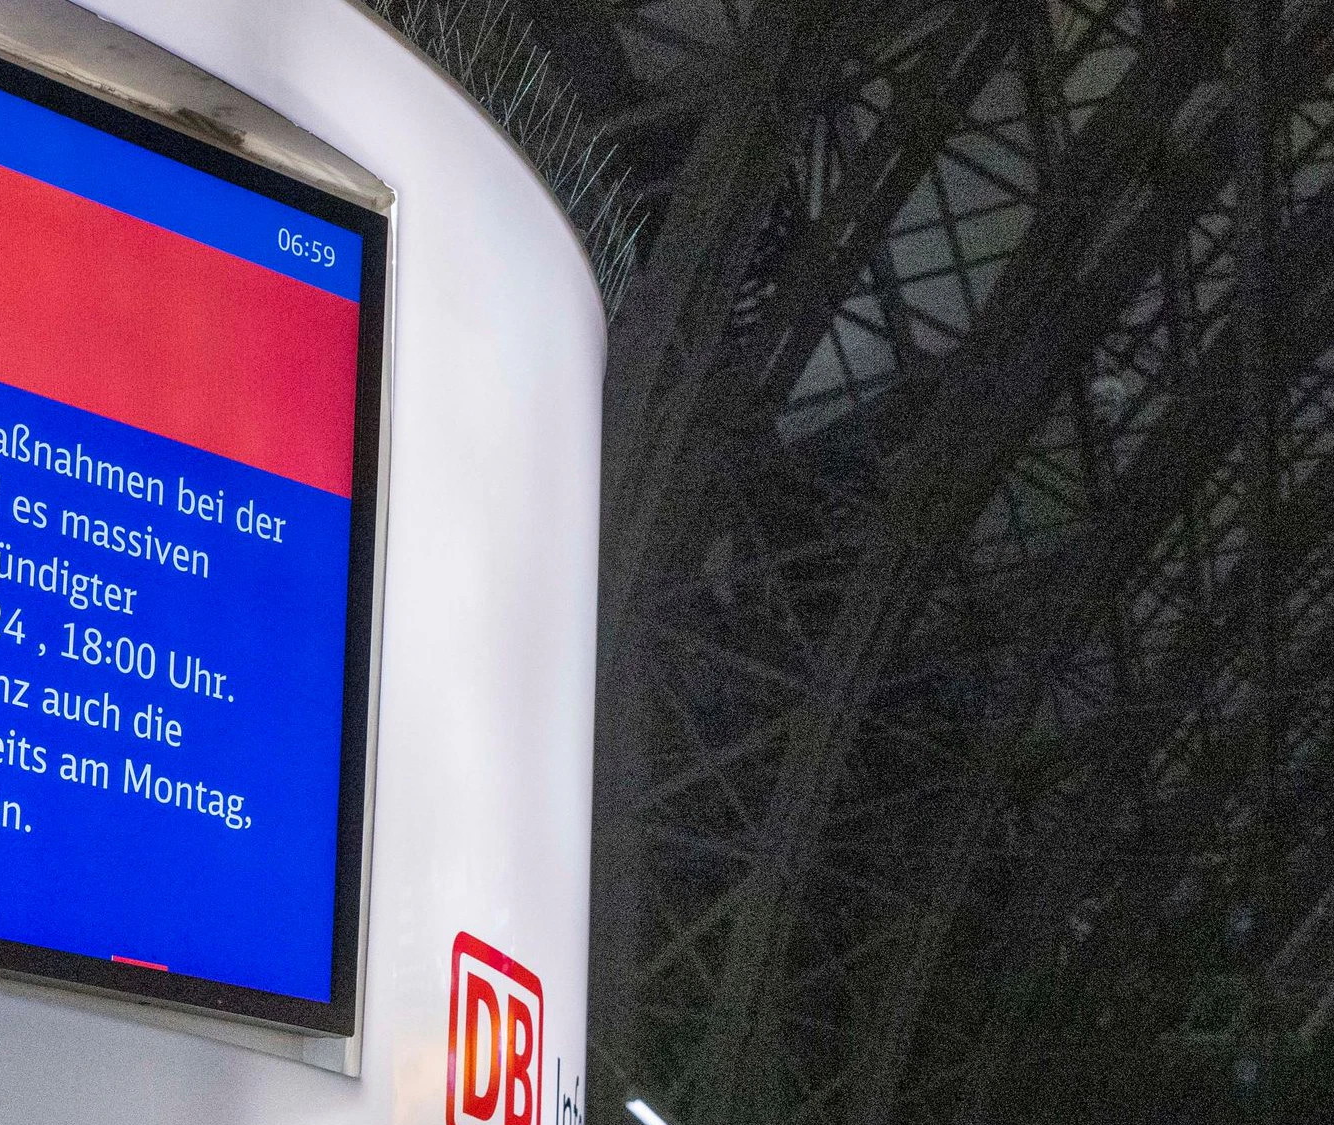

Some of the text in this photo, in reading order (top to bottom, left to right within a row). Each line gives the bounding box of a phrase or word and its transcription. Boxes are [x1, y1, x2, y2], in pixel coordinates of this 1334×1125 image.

[277, 227, 336, 268] 06:59
[13, 496, 47, 528] es
[62, 510, 209, 578] massiven
[178, 477, 224, 523] bei
[236, 500, 286, 543] der
[61, 622, 156, 680] 18:00
[169, 651, 234, 702] Uhr.
[42, 687, 120, 731] auch
[133, 704, 182, 747] die
[59, 753, 109, 789] am
[123, 759, 252, 830] Montag,
